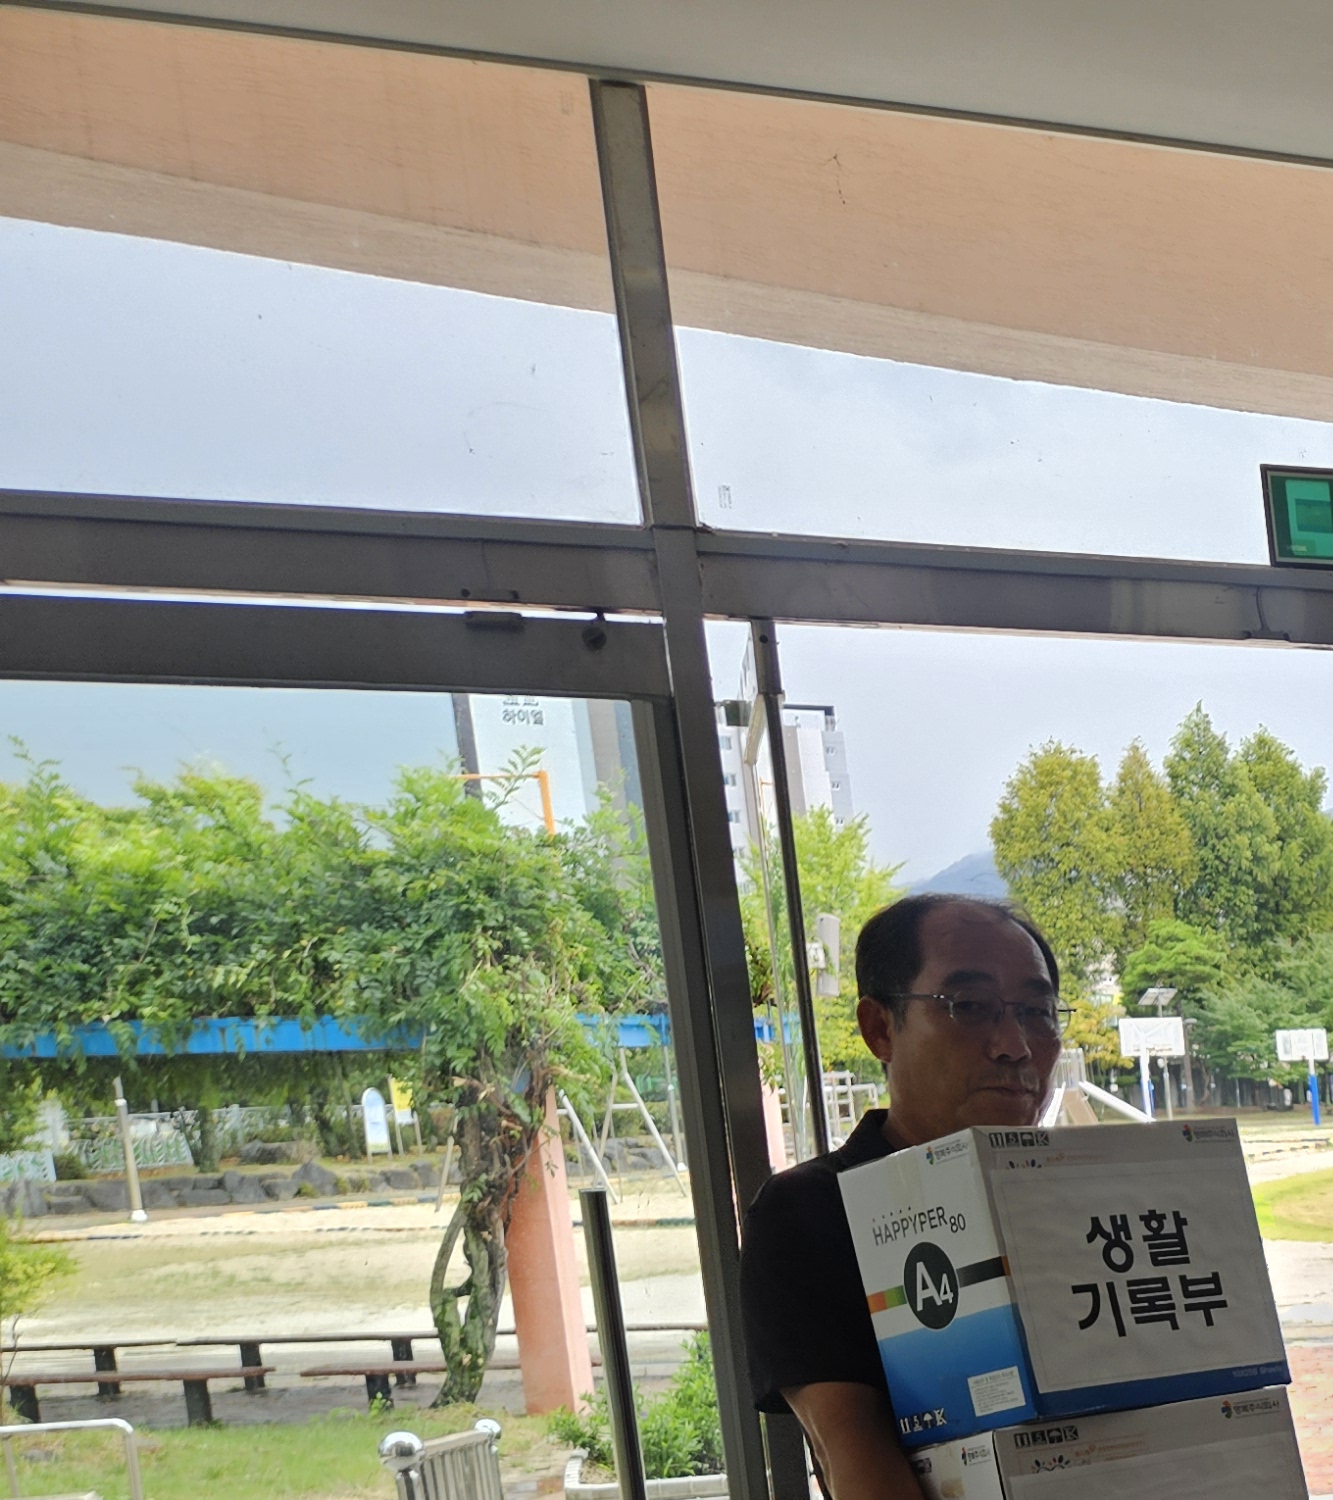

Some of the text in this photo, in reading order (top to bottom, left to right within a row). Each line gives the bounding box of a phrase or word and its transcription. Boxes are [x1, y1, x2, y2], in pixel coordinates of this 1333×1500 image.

[872, 1206, 966, 1246] HAPPYPER 80
[1086, 1209, 1191, 1273] 생활
[916, 1261, 954, 1312] A4
[1072, 1272, 1229, 1337] 기록부
